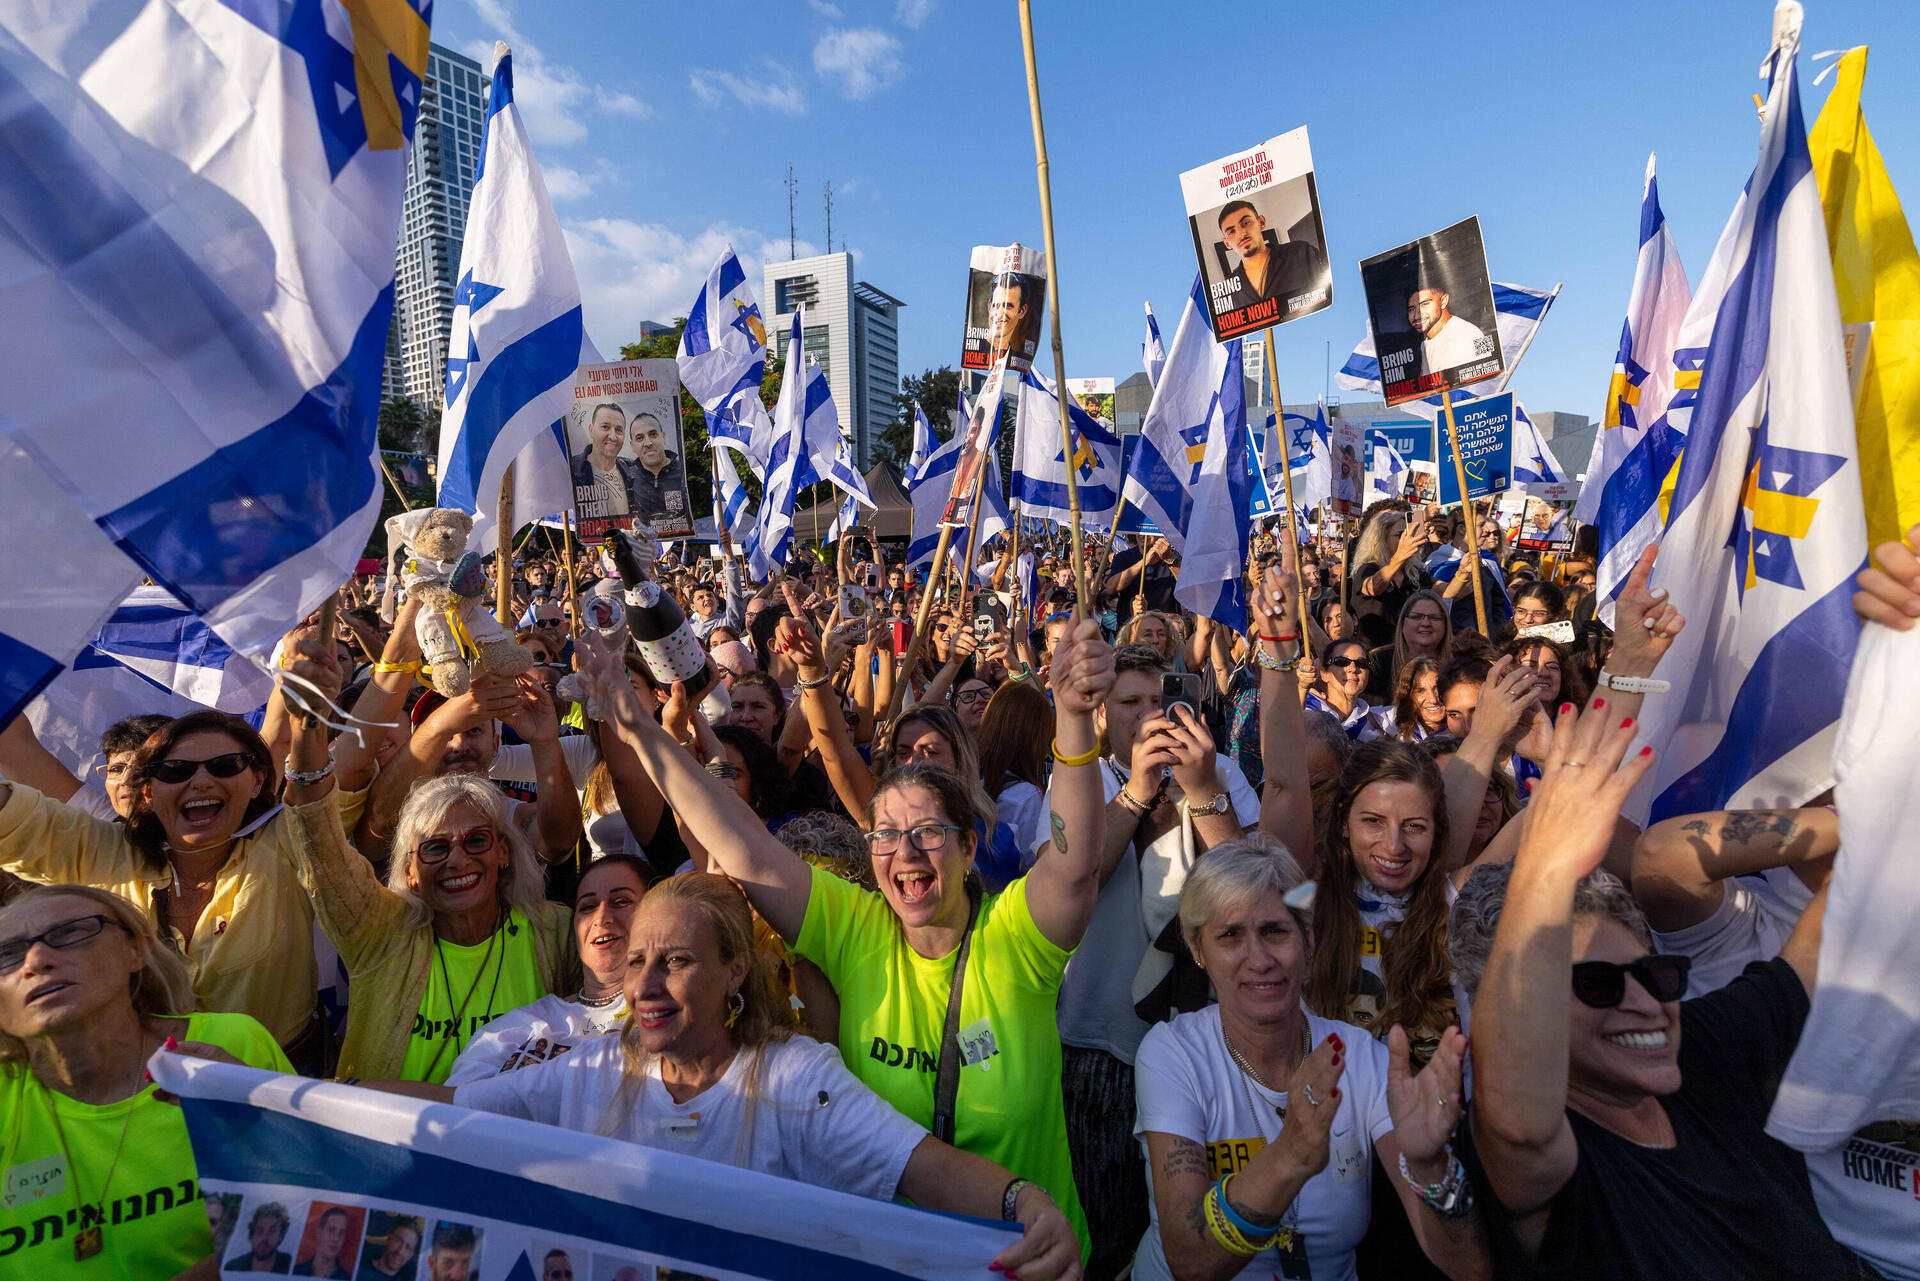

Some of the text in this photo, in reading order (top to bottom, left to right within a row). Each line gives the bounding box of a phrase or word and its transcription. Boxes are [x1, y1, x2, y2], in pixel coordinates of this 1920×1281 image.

[1255, 151, 1267, 163] רום
[1219, 160, 1274, 188] ROM BRASLAVSKI
[1210, 275, 1242, 299] BRING
[1213, 295, 1234, 315] HIM
[1217, 296, 1278, 331] HOME NOW!
[966, 327, 989, 340] BRING
[965, 338, 980, 350] HIM
[964, 351, 985, 365] HOME
[1381, 348, 1414, 370] BRING
[588, 369, 611, 382] שרעבי
[629, 366, 643, 378] אלי
[1384, 365, 1406, 384] HIM
[574, 379, 659, 399] ELI AND YOSSI SHARABI
[1386, 378, 1417, 399] HOME
[1464, 410, 1487, 422] אתם
[1471, 414, 1508, 430] הנשימה
[1476, 424, 1505, 438] שלהם
[1473, 442, 1503, 457] שאתם
[575, 485, 609, 501] BRING
[577, 501, 608, 518] THEM
[580, 518, 612, 536] HOME
[1847, 1139, 1920, 1166] BRING
[1842, 1150, 1908, 1192] HOME
